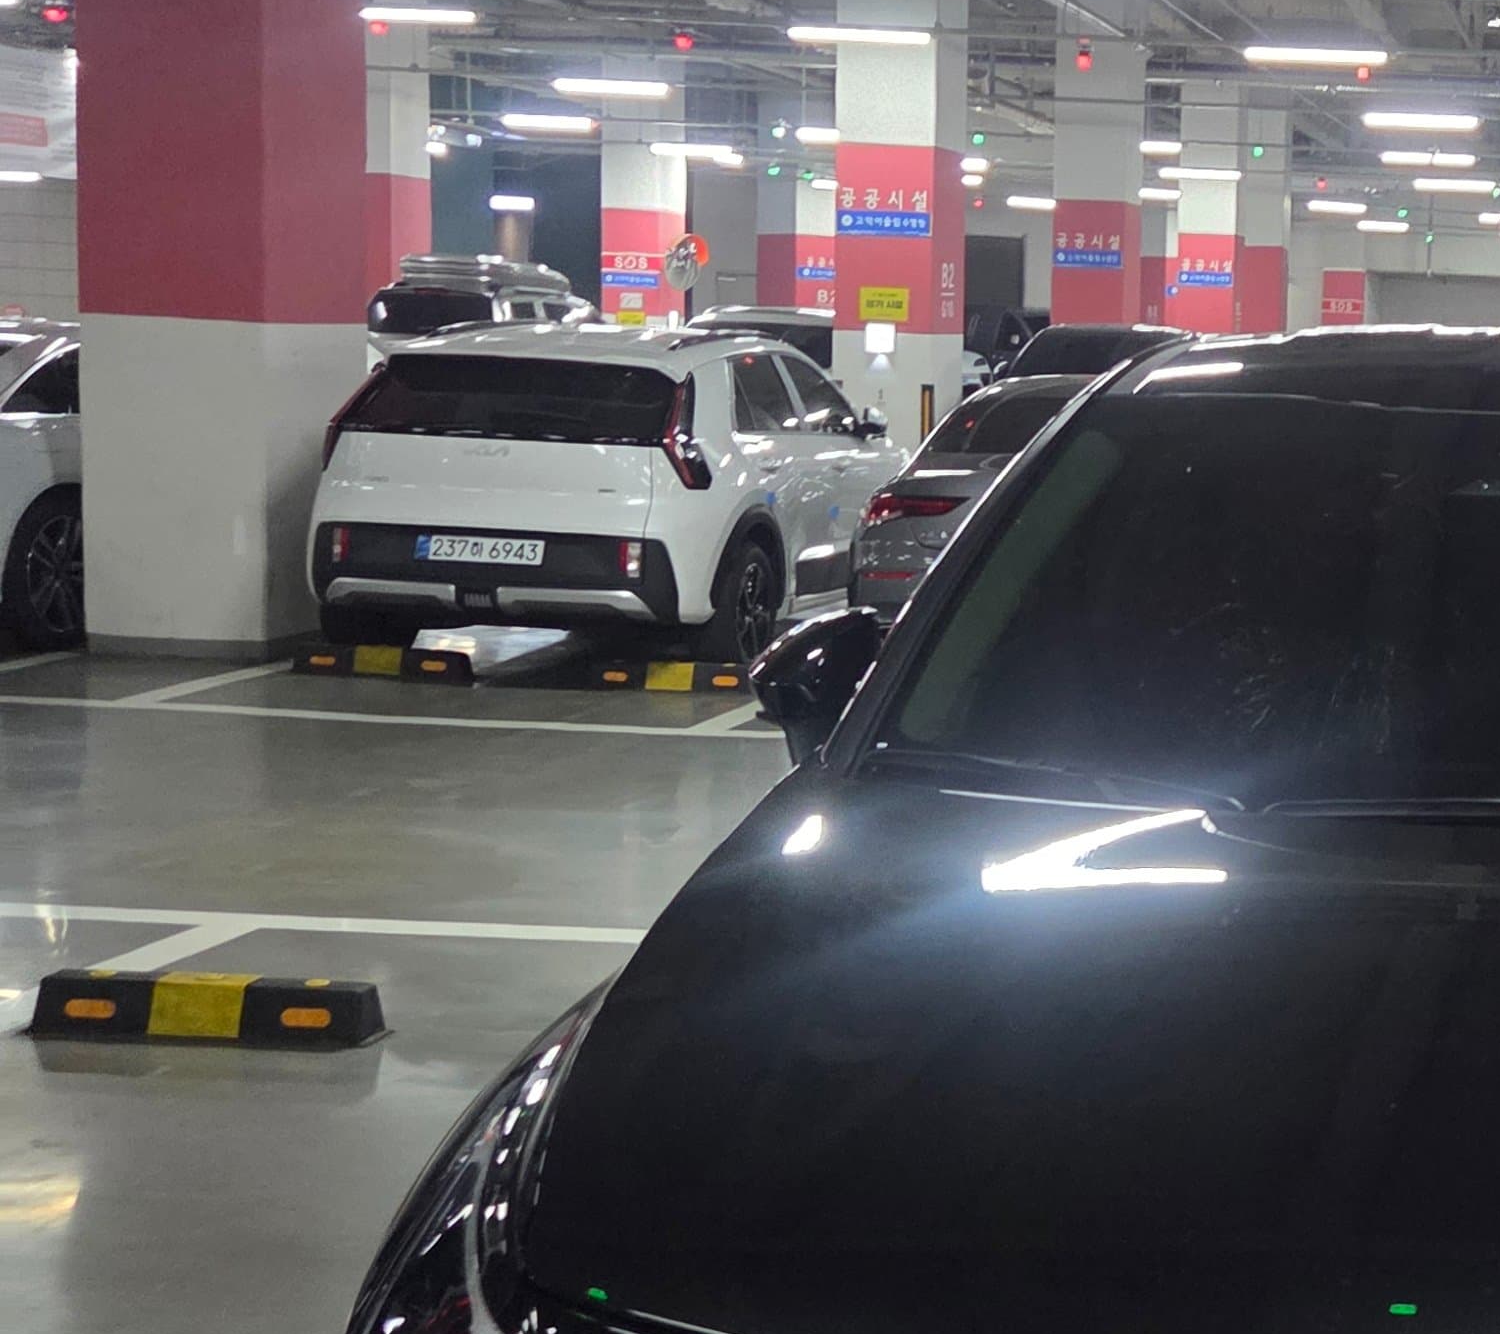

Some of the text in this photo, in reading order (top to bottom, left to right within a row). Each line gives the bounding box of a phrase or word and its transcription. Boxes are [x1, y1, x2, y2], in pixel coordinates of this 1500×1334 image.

[840, 186, 928, 213] 공공시설
[614, 256, 649, 269] SOS
[941, 263, 955, 288] B2
[488, 541, 538, 562] 6943
